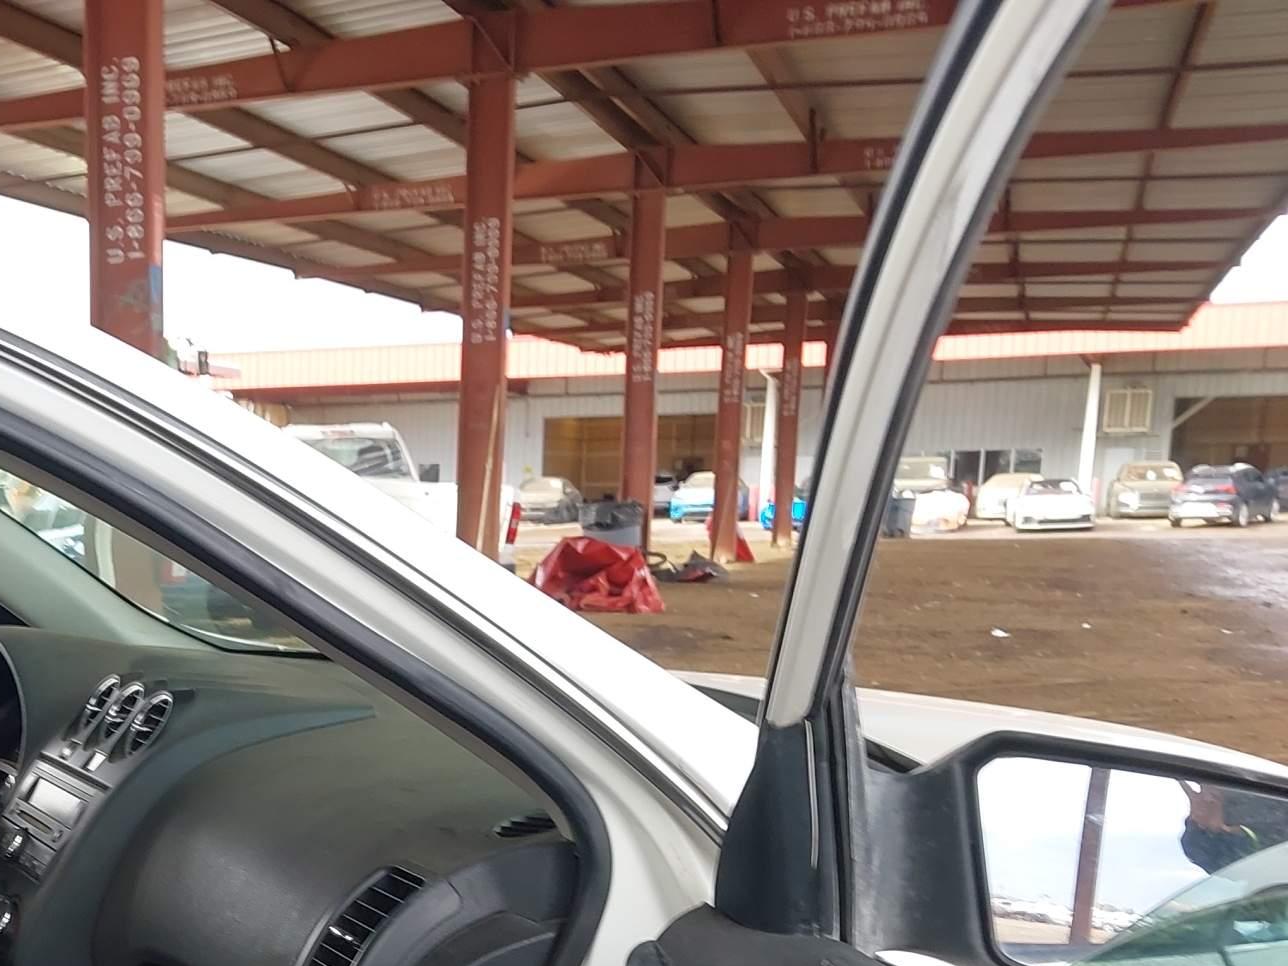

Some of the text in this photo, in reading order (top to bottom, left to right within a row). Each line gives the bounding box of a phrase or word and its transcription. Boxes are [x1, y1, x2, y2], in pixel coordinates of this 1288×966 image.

[100, 56, 125, 264] U.S. PREFAB INC.
